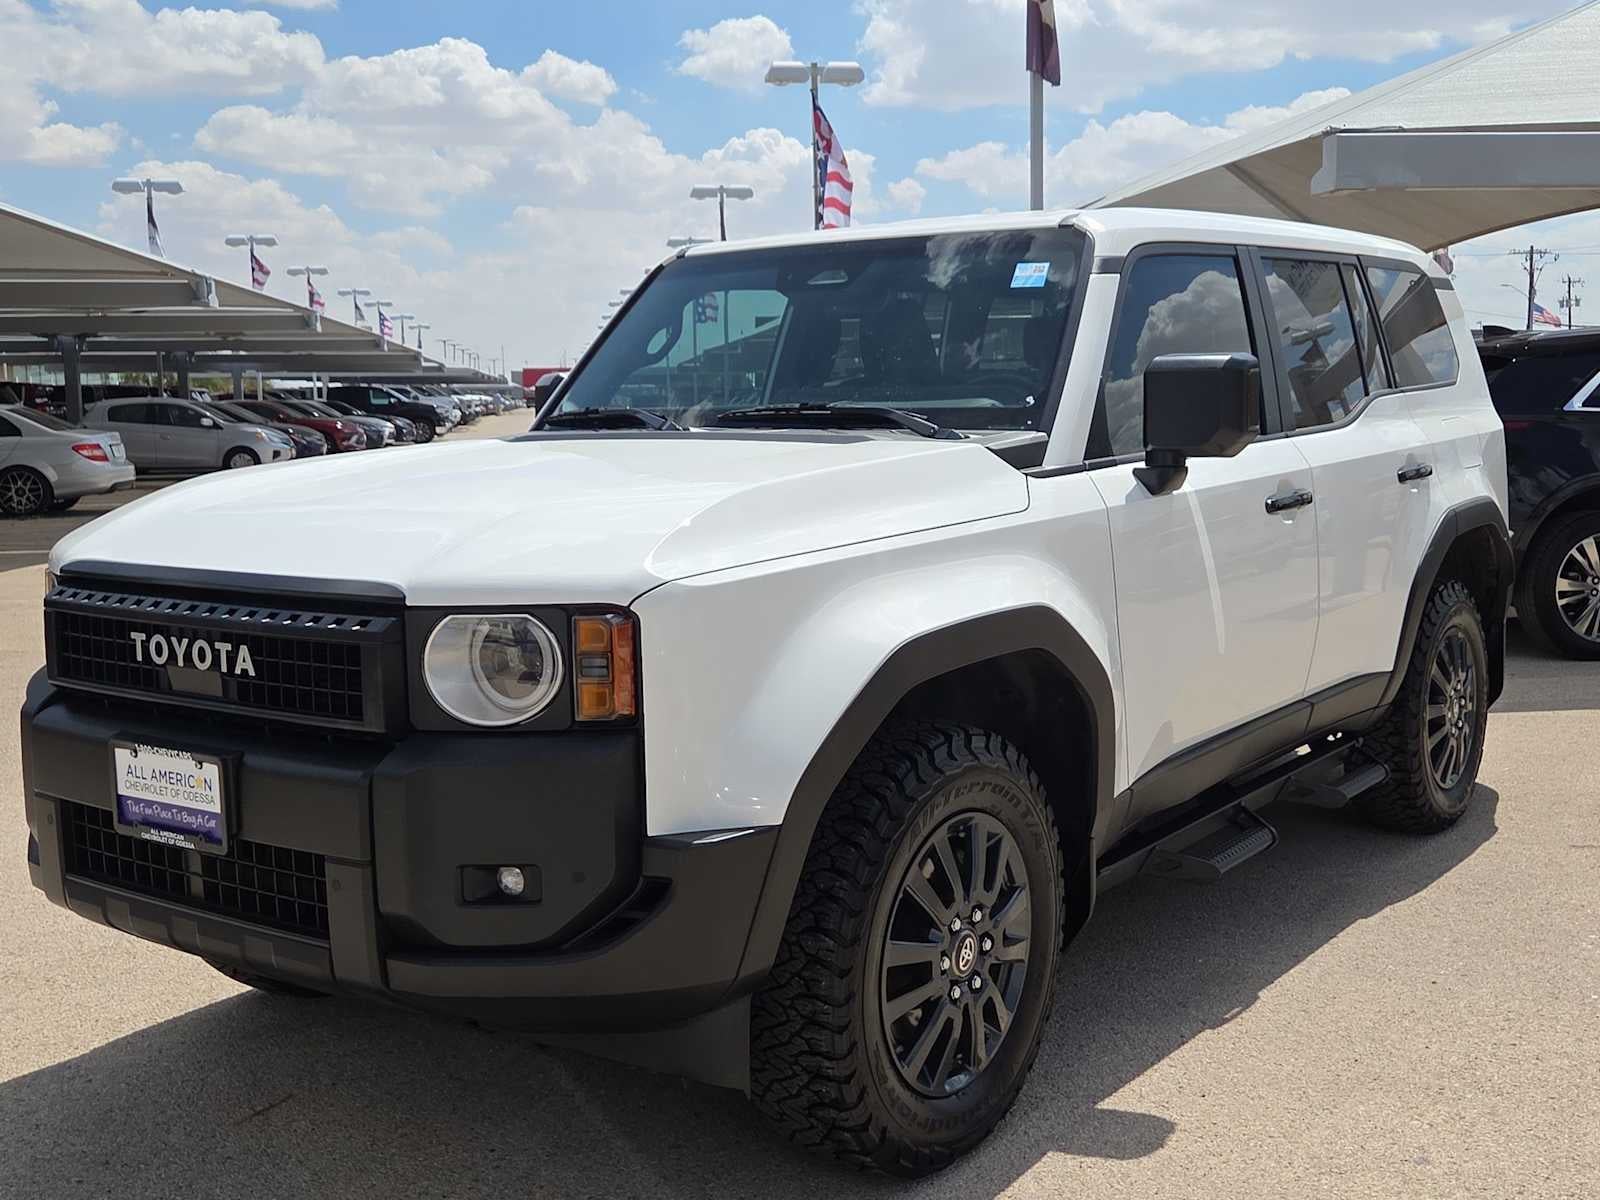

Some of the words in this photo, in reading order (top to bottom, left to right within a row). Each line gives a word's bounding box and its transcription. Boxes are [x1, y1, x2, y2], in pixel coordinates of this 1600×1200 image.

[130, 631, 256, 677] TOYOTA
[126, 763, 147, 780] ALL
[150, 768, 213, 793] AMERICN
[124, 779, 169, 797] CHEVROLET
[170, 788, 181, 799] OF
[182, 790, 216, 806] ODESSA
[126, 800, 139, 814] The
[140, 803, 154, 817] Fun
[171, 809, 182, 821] To
[182, 811, 197, 829] Buy
[196, 815, 204, 826] A
[204, 816, 217, 828] Car
[141, 832, 168, 844] CHEVROLET
[175, 839, 196, 849] ODESSA
[160, 830, 184, 841] AMERICAN
